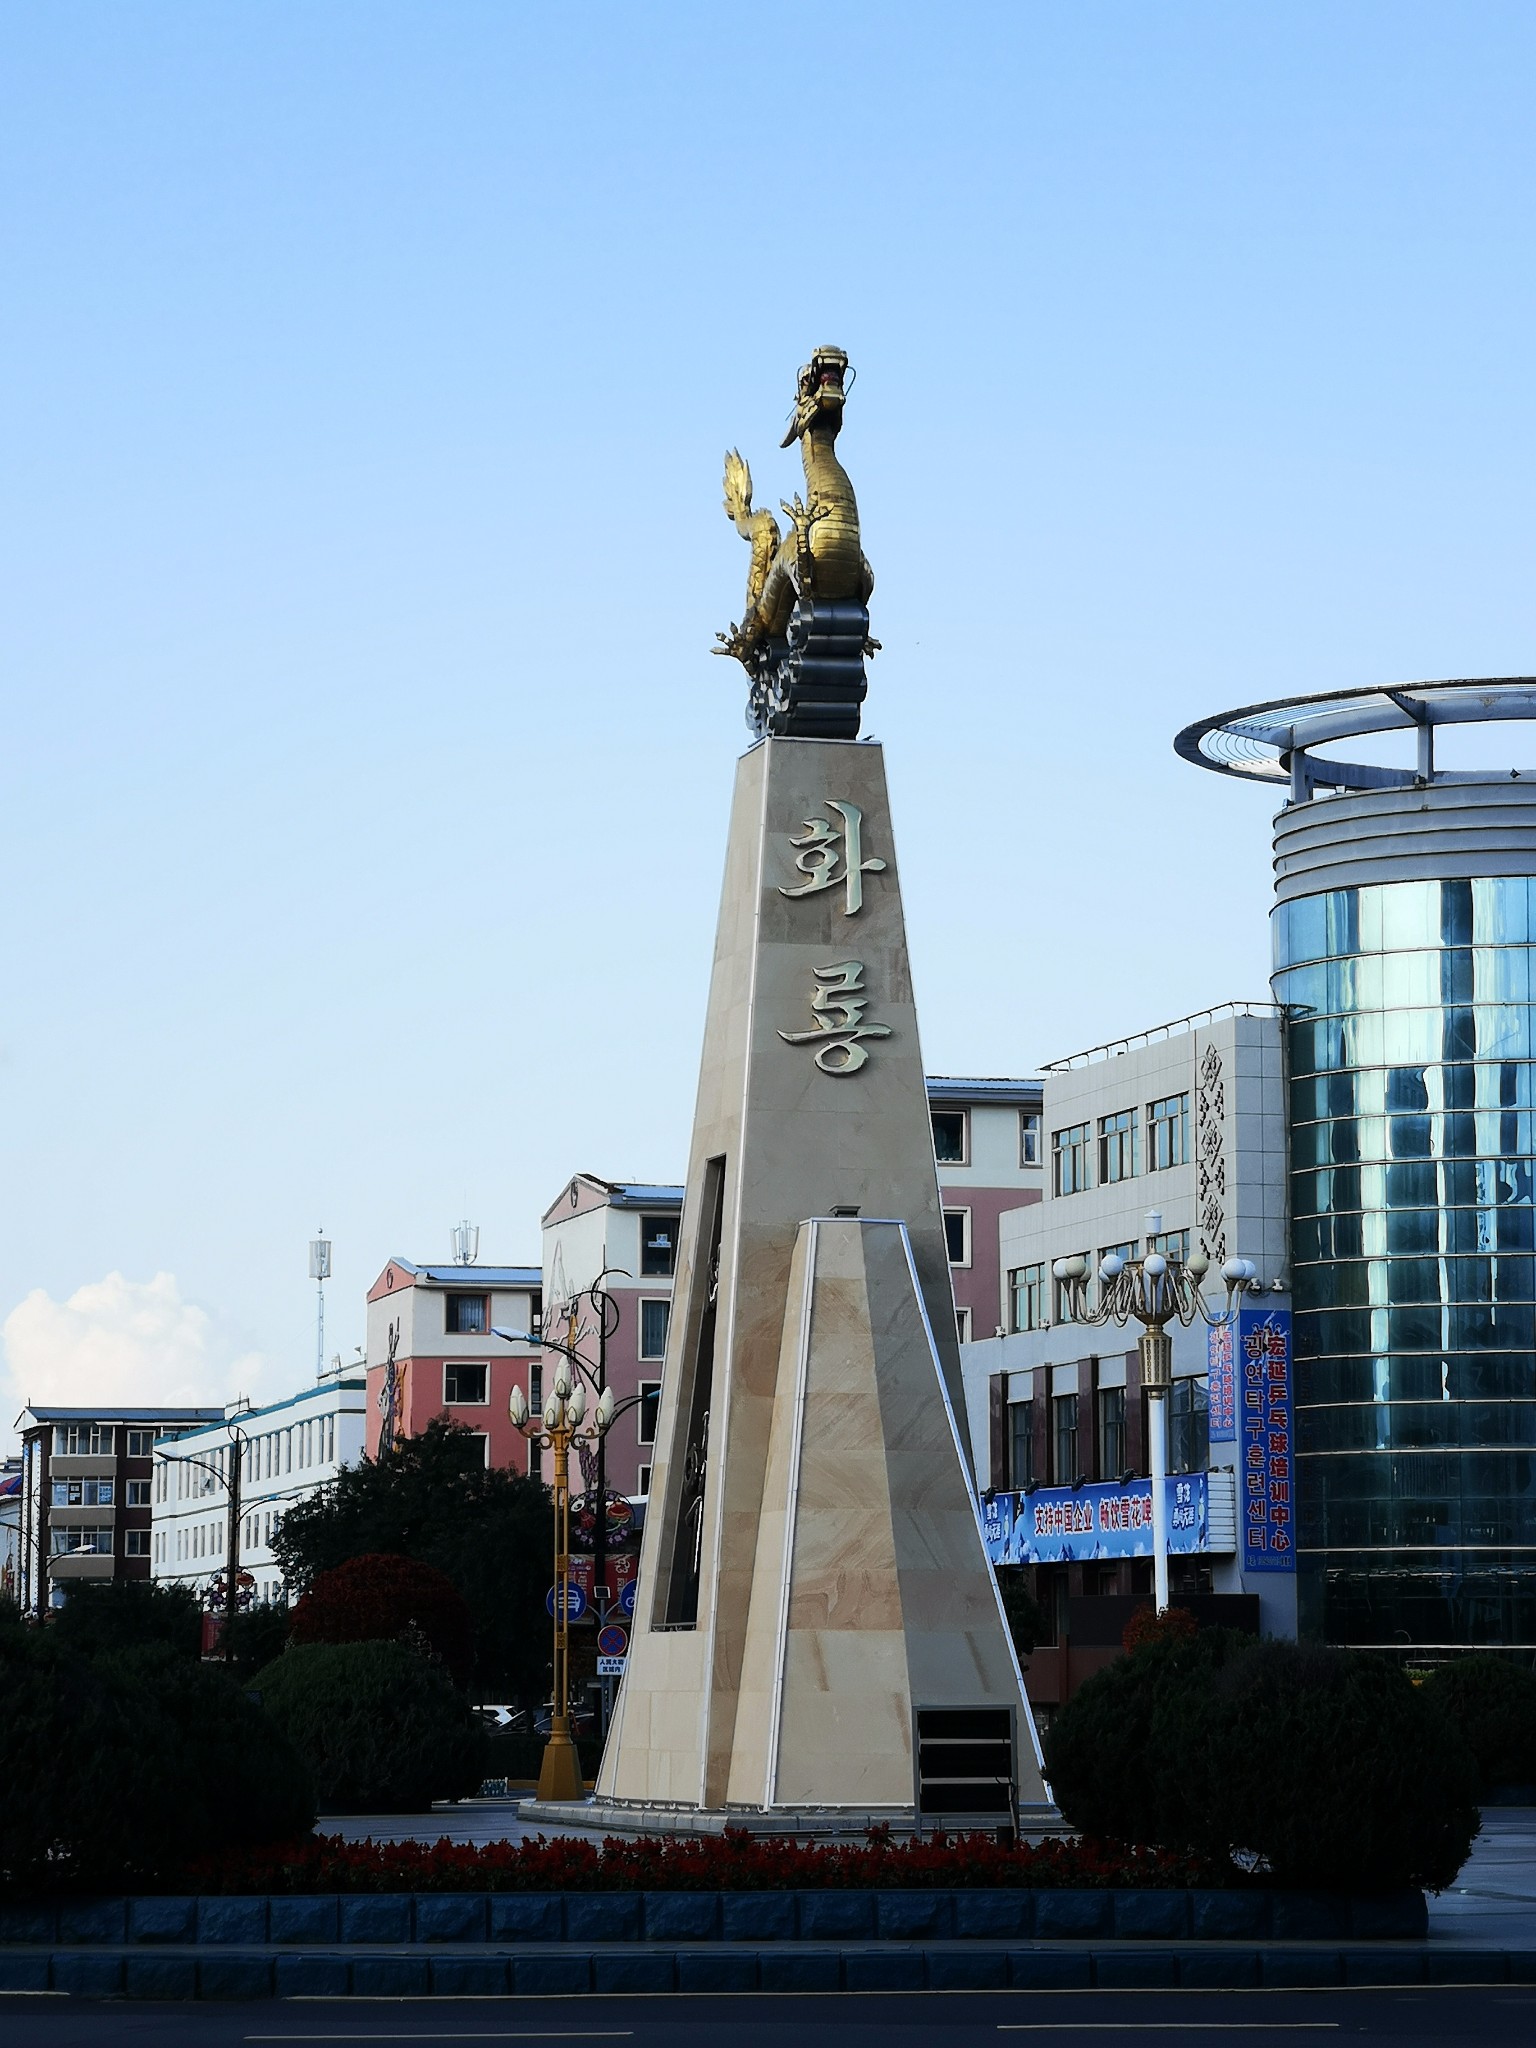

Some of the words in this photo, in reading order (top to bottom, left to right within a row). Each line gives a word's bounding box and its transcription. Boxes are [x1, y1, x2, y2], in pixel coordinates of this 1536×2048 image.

[777, 798, 893, 1078] 화룡
[1034, 1499, 1094, 1538] 支持中国企业
[1244, 1335, 1268, 1550] 굉연탁구훈련센터
[1267, 1335, 1291, 1551] 宏延乒乓球培训中心
